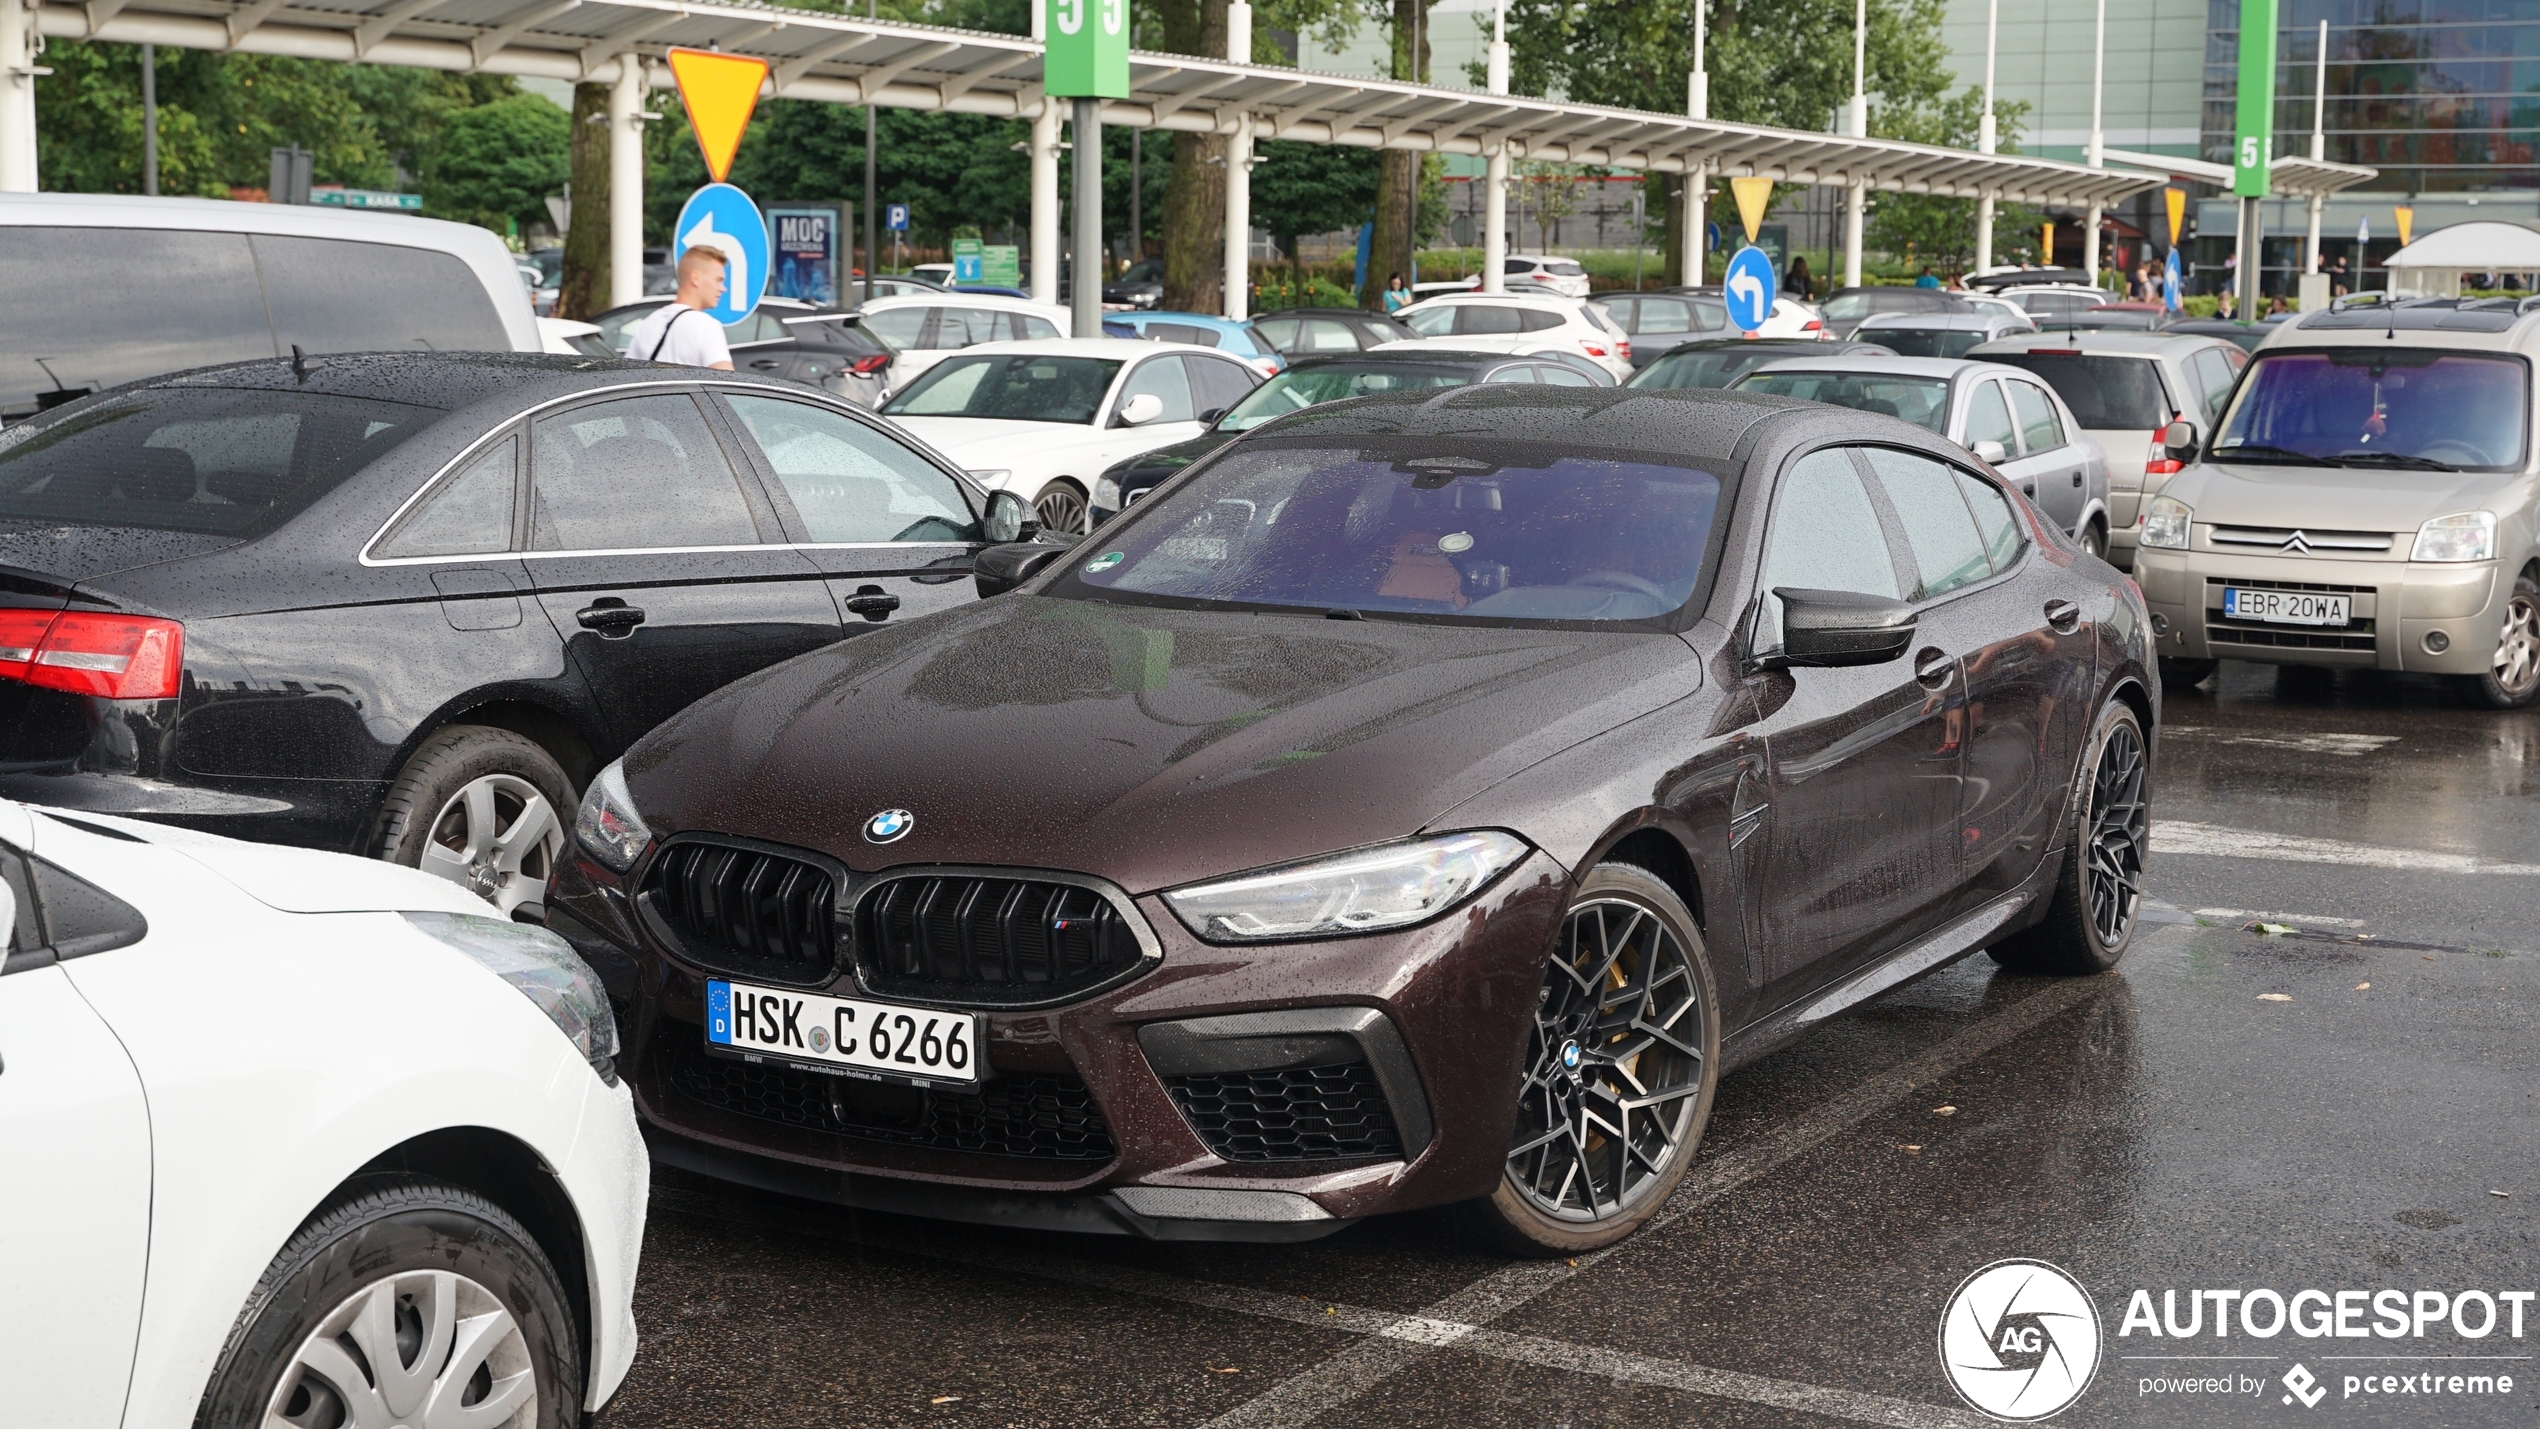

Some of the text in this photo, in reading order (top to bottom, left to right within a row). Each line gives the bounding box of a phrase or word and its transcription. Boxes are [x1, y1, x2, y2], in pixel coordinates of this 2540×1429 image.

[1058, 0, 1083, 35] 5
[2240, 136, 2258, 169] 5
[780, 217, 825, 242] MOC
[890, 206, 905, 228] P
[2239, 592, 2342, 620] EBR 20WA
[715, 1018, 725, 1034] D
[734, 990, 805, 1049] HSK
[834, 1006, 857, 1055] C
[869, 1011, 969, 1070] 6266
[744, 1054, 931, 1089] BMW www.autohaus-holme.de MINI
